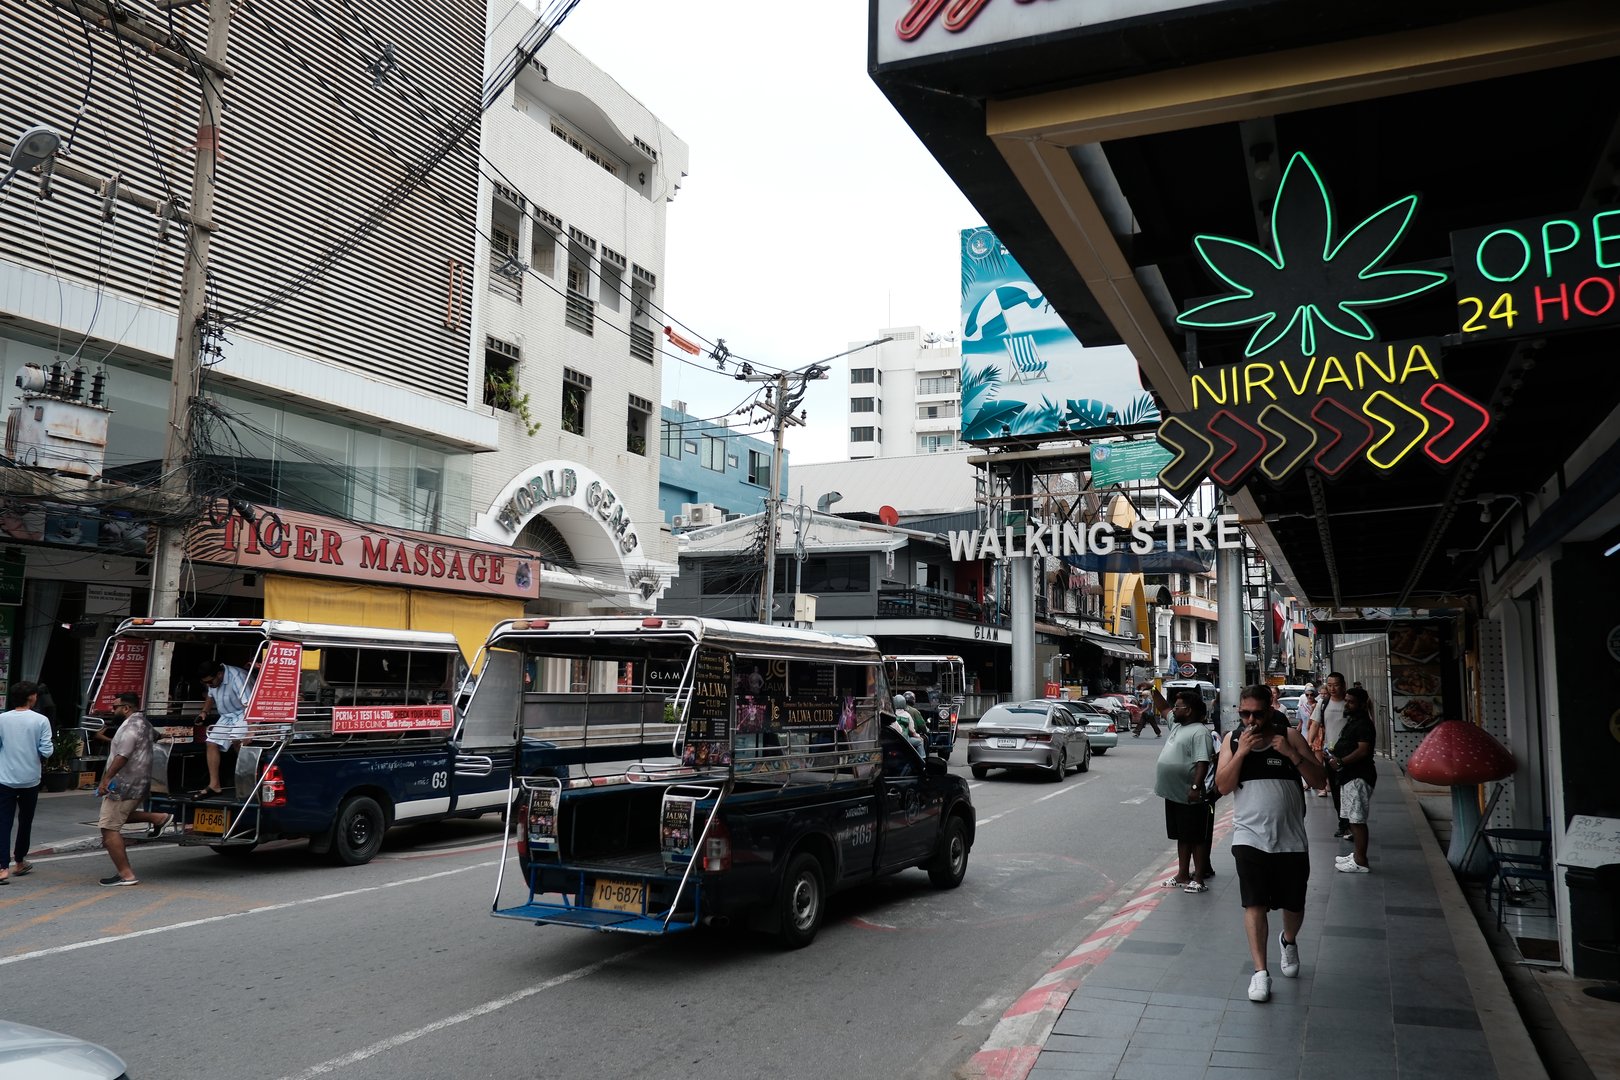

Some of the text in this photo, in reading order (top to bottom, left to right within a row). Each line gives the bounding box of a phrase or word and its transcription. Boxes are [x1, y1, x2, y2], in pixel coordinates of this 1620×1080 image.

[1457, 277, 1620, 333] 24 HO
[1191, 345, 1439, 409] NIRVANA
[496, 468, 578, 534] WORLD
[948, 514, 1243, 561] WALKING STRE
[216, 514, 506, 586] TIGER MASSAGE
[974, 625, 999, 641] GLAM
[127, 645, 146, 653] TEST
[273, 647, 298, 656] 1 TEST
[115, 653, 125, 661] 14
[279, 658, 297, 666] STDs
[650, 671, 680, 680] GLAM
[696, 681, 728, 698] JALWA
[360, 711, 373, 720] TEST
[374, 711, 380, 720] 14
[788, 709, 834, 723] JALWA CLUB
[432, 771, 447, 789] 63
[196, 812, 225, 826] 10-646
[666, 812, 688, 821] JALWA
